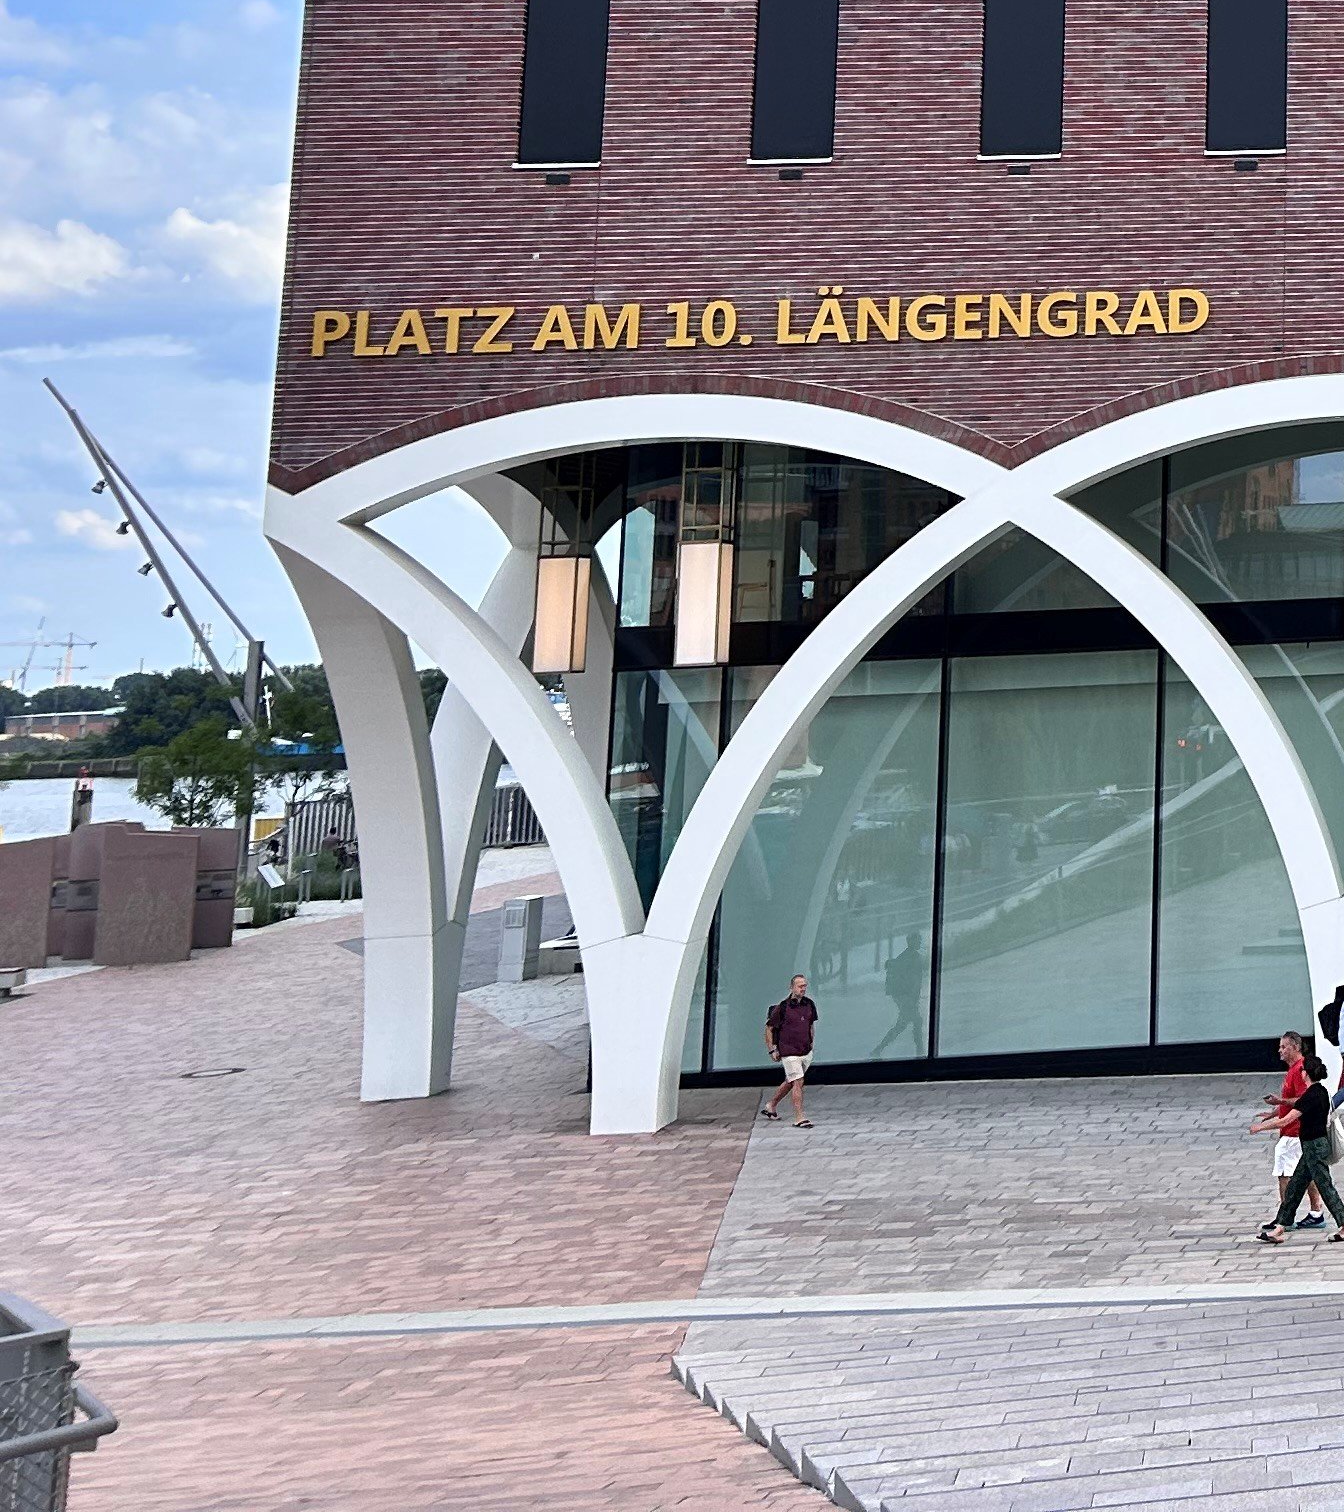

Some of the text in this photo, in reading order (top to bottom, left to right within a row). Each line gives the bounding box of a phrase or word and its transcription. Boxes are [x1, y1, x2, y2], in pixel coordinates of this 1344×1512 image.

[311, 285, 1212, 357] PLATZ AM 10. LÄNGENGRAD
